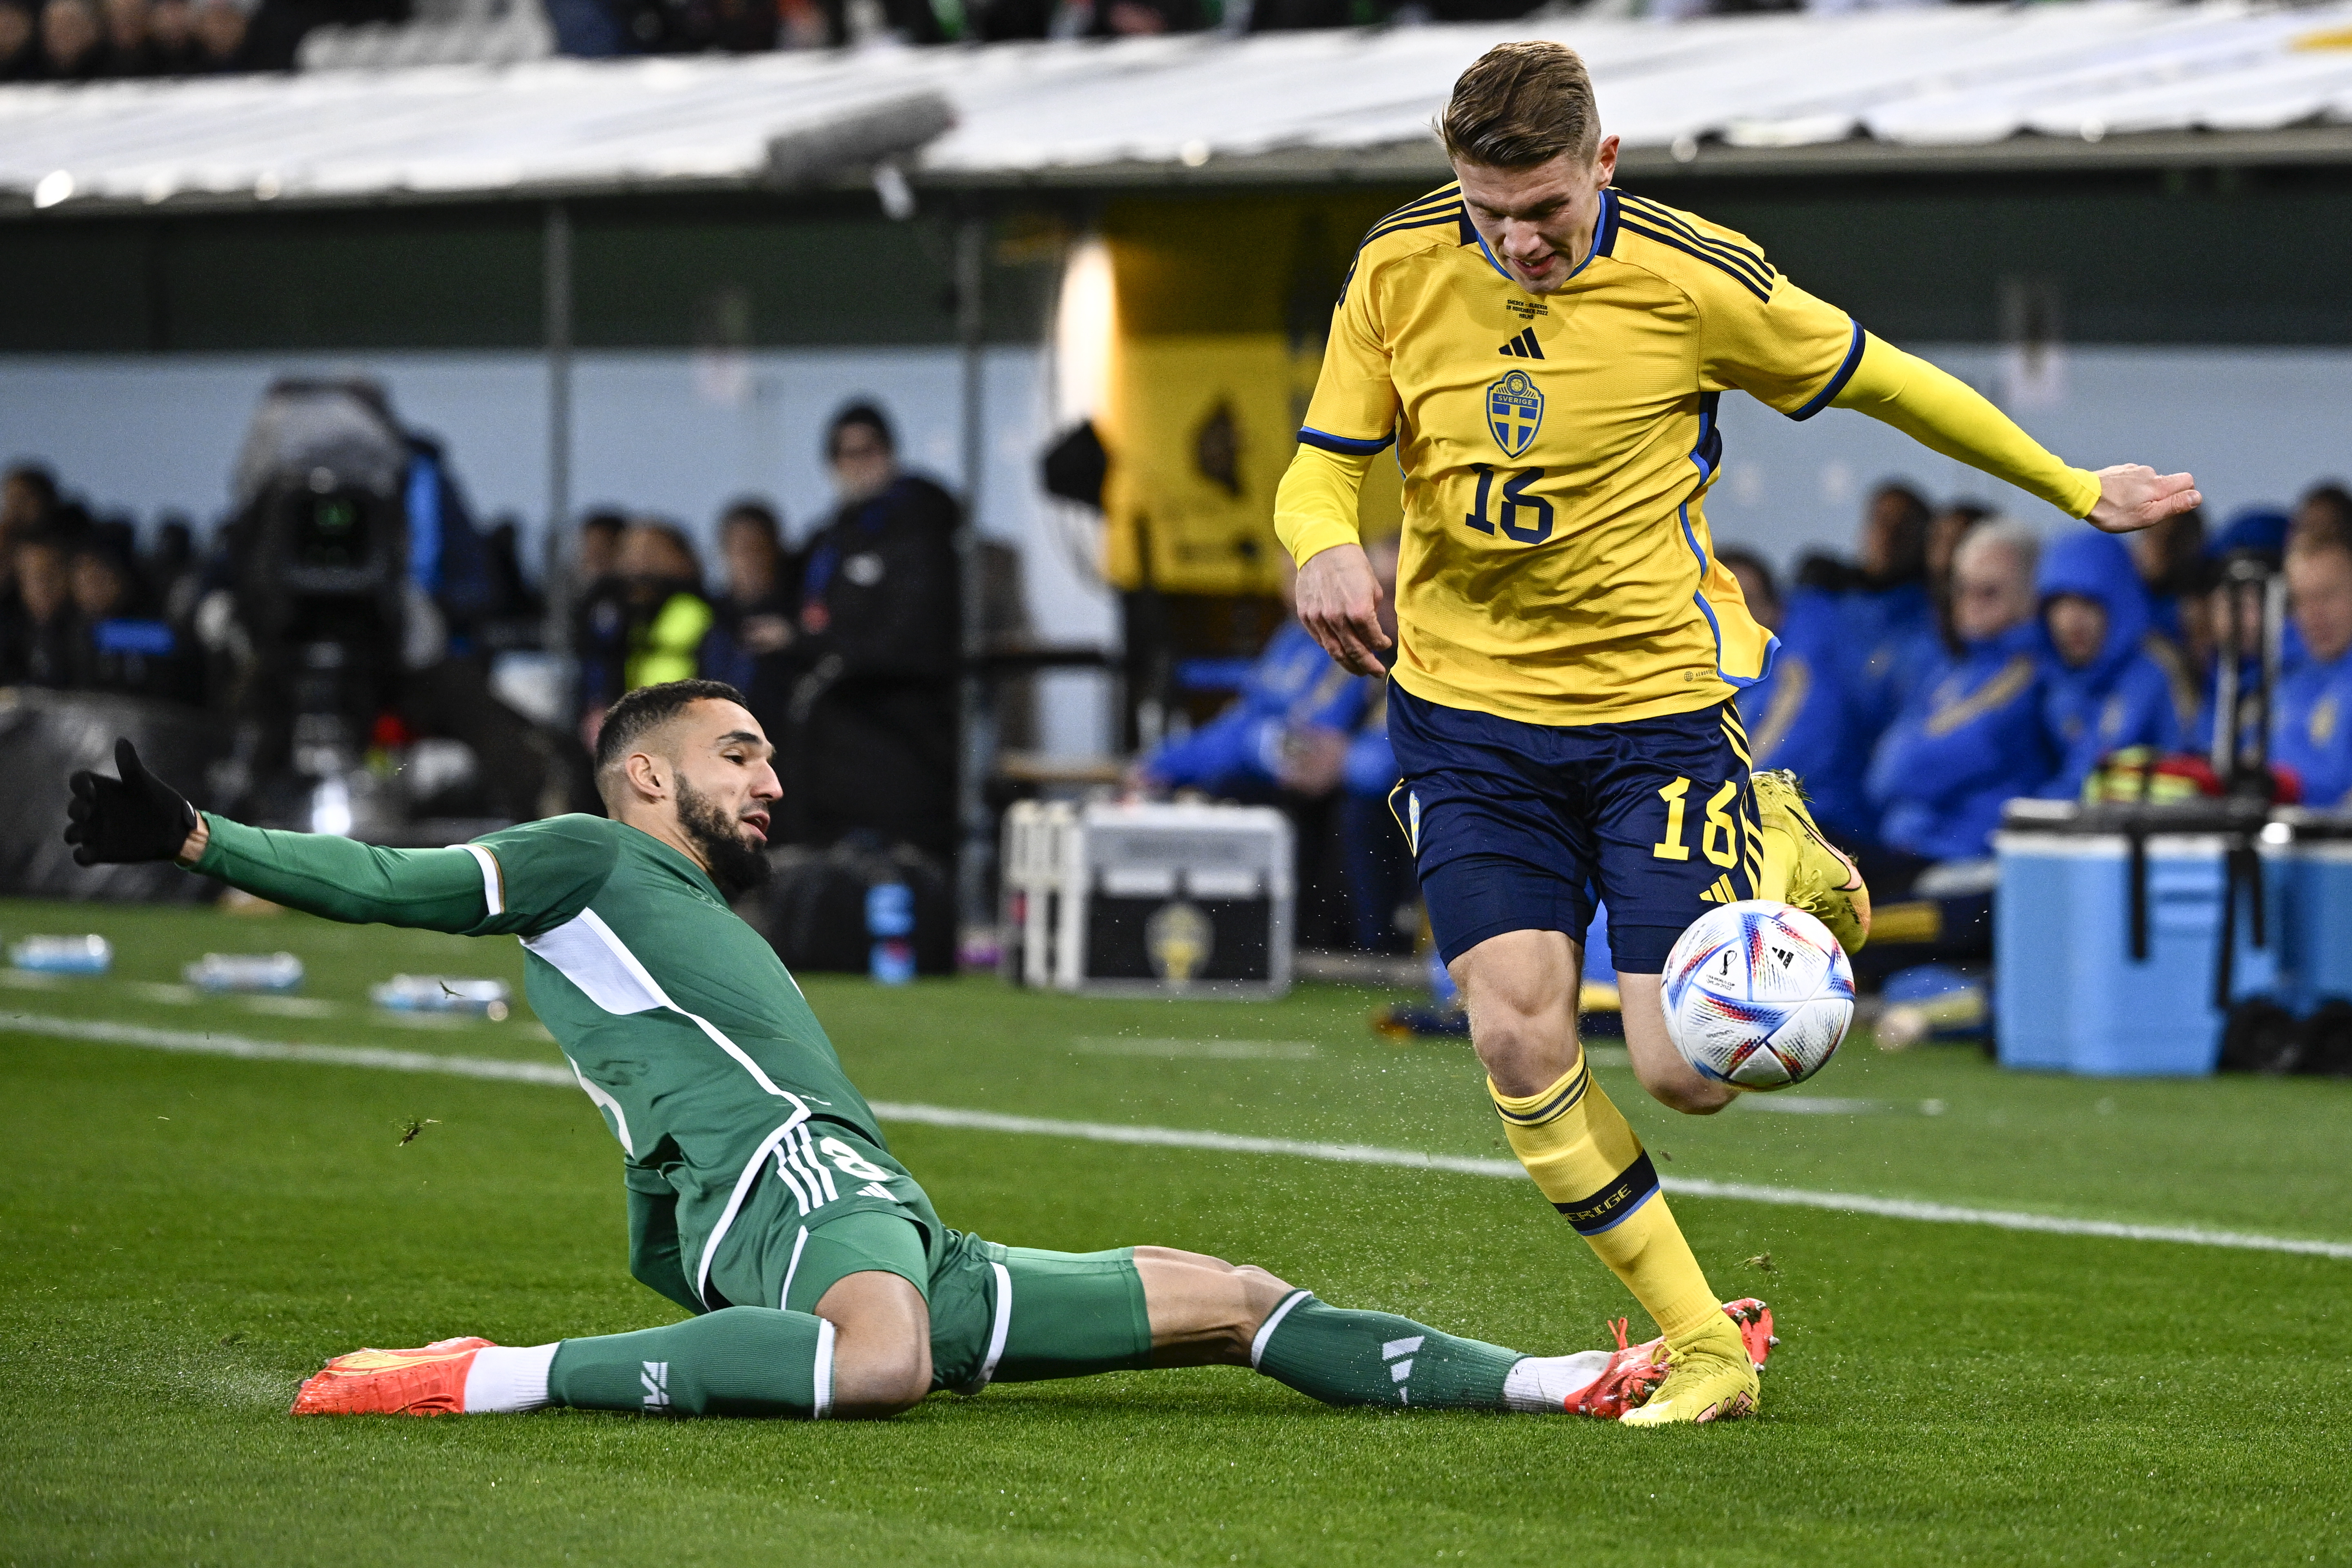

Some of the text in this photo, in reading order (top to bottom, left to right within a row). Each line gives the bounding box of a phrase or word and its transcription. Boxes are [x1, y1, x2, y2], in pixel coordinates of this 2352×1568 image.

[1512, 306, 1535, 314] NOVEMBER
[1498, 395, 1533, 405] SVERIGE
[1466, 462, 1554, 545] 16
[1653, 776, 1739, 869] 16
